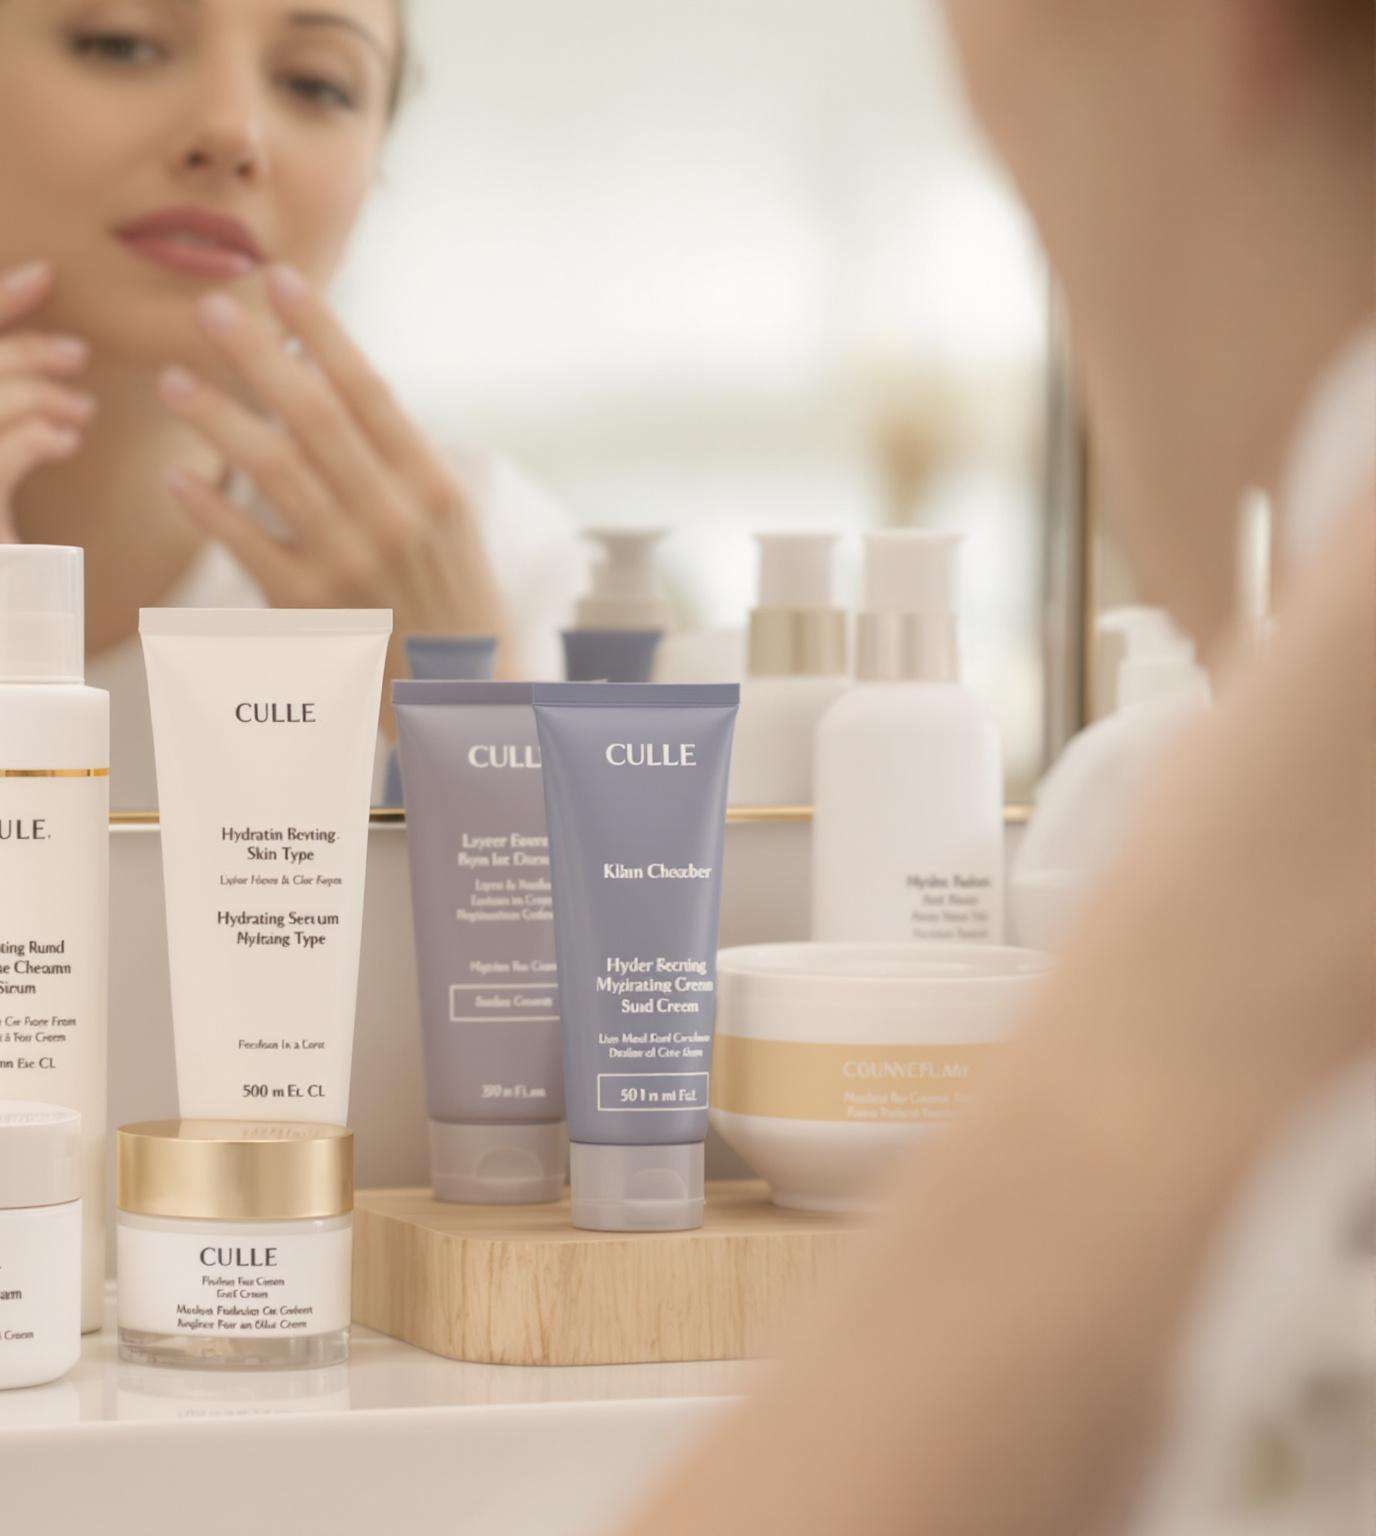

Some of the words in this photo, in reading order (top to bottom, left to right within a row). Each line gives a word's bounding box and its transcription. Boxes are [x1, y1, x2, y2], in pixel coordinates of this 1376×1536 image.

[235, 703, 318, 723] CULLE
[468, 744, 542, 768] CULL
[605, 743, 697, 767] CULLE
[247, 847, 277, 861] Skin
[281, 847, 316, 864] Type
[217, 911, 285, 929] Hydrating
[294, 931, 327, 950] Type
[242, 1084, 269, 1098] 500
[199, 1246, 278, 1267] CULLE
